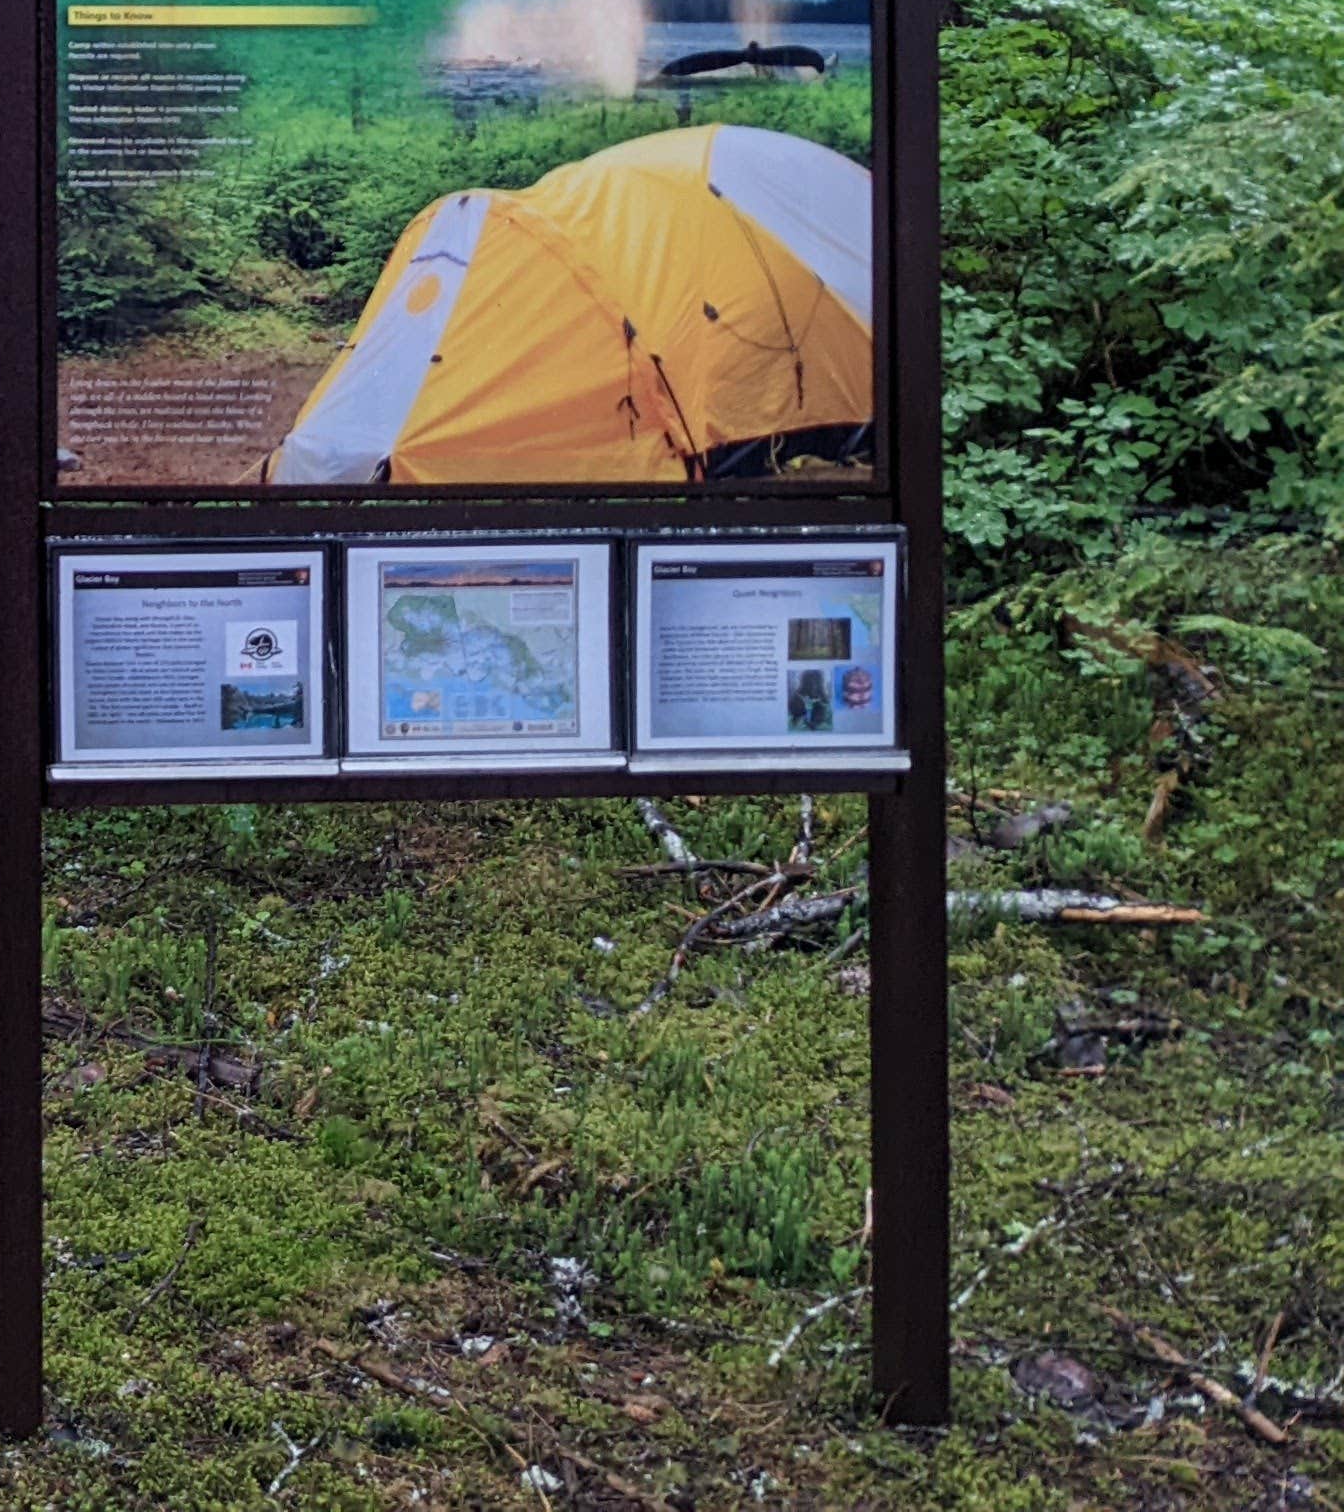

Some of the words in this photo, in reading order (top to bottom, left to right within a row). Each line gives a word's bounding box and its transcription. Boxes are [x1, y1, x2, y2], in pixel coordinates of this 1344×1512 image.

[74, 11, 107, 22] Things
[123, 11, 153, 20] Know
[653, 565, 681, 574] Glacier
[682, 565, 698, 575] Bay
[75, 573, 102, 584] Glacier
[104, 573, 120, 585] Bay
[142, 599, 187, 610] Neighbors
[217, 598, 243, 607] North
